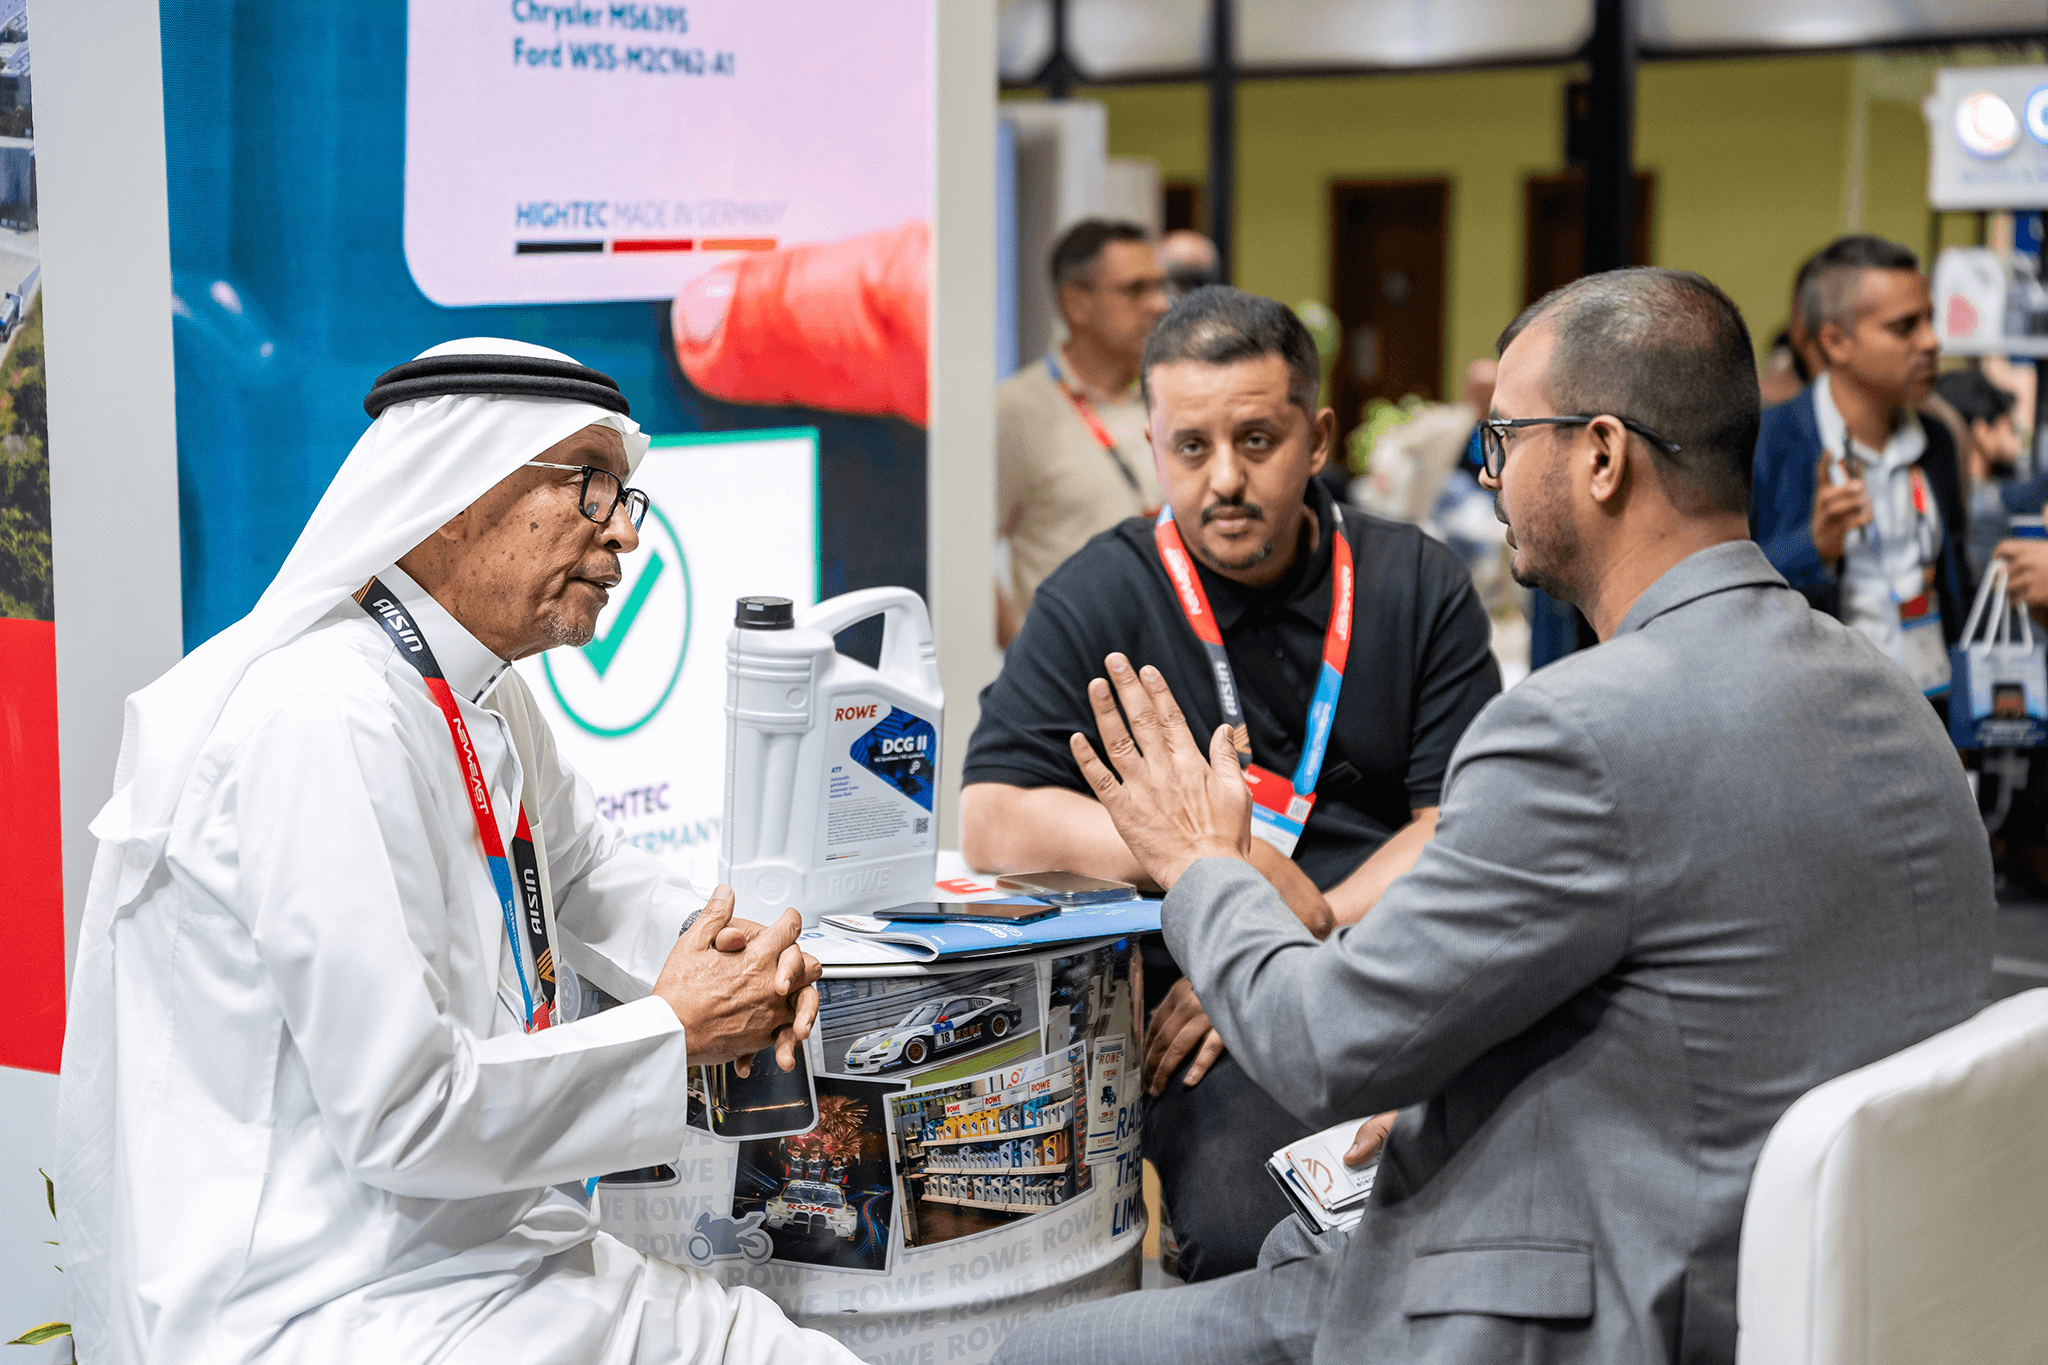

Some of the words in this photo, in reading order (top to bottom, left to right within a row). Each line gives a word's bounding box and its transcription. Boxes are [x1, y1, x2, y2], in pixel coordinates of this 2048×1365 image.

[513, 36, 563, 68] Ford
[515, 200, 607, 228] HIGHTEC
[372, 597, 424, 654] AISIN
[834, 704, 878, 722] ROWE
[881, 736, 915, 755] DCG
[830, 766, 843, 774] ATF
[596, 783, 670, 821] GHTEC
[523, 868, 543, 935] AISIN
[940, 1031, 951, 1044] 18
[955, 1023, 983, 1040] ROWE
[1099, 1052, 1121, 1065] ROWE
[1030, 1079, 1051, 1093] ROWE
[946, 1104, 961, 1113] ROWE
[984, 1094, 1002, 1105] ROWE
[786, 1203, 836, 1215] ROWE
[837, 1270, 935, 1314] ROWE
[946, 1238, 1033, 1290] ROWE
[1041, 1199, 1102, 1254] ROWE
